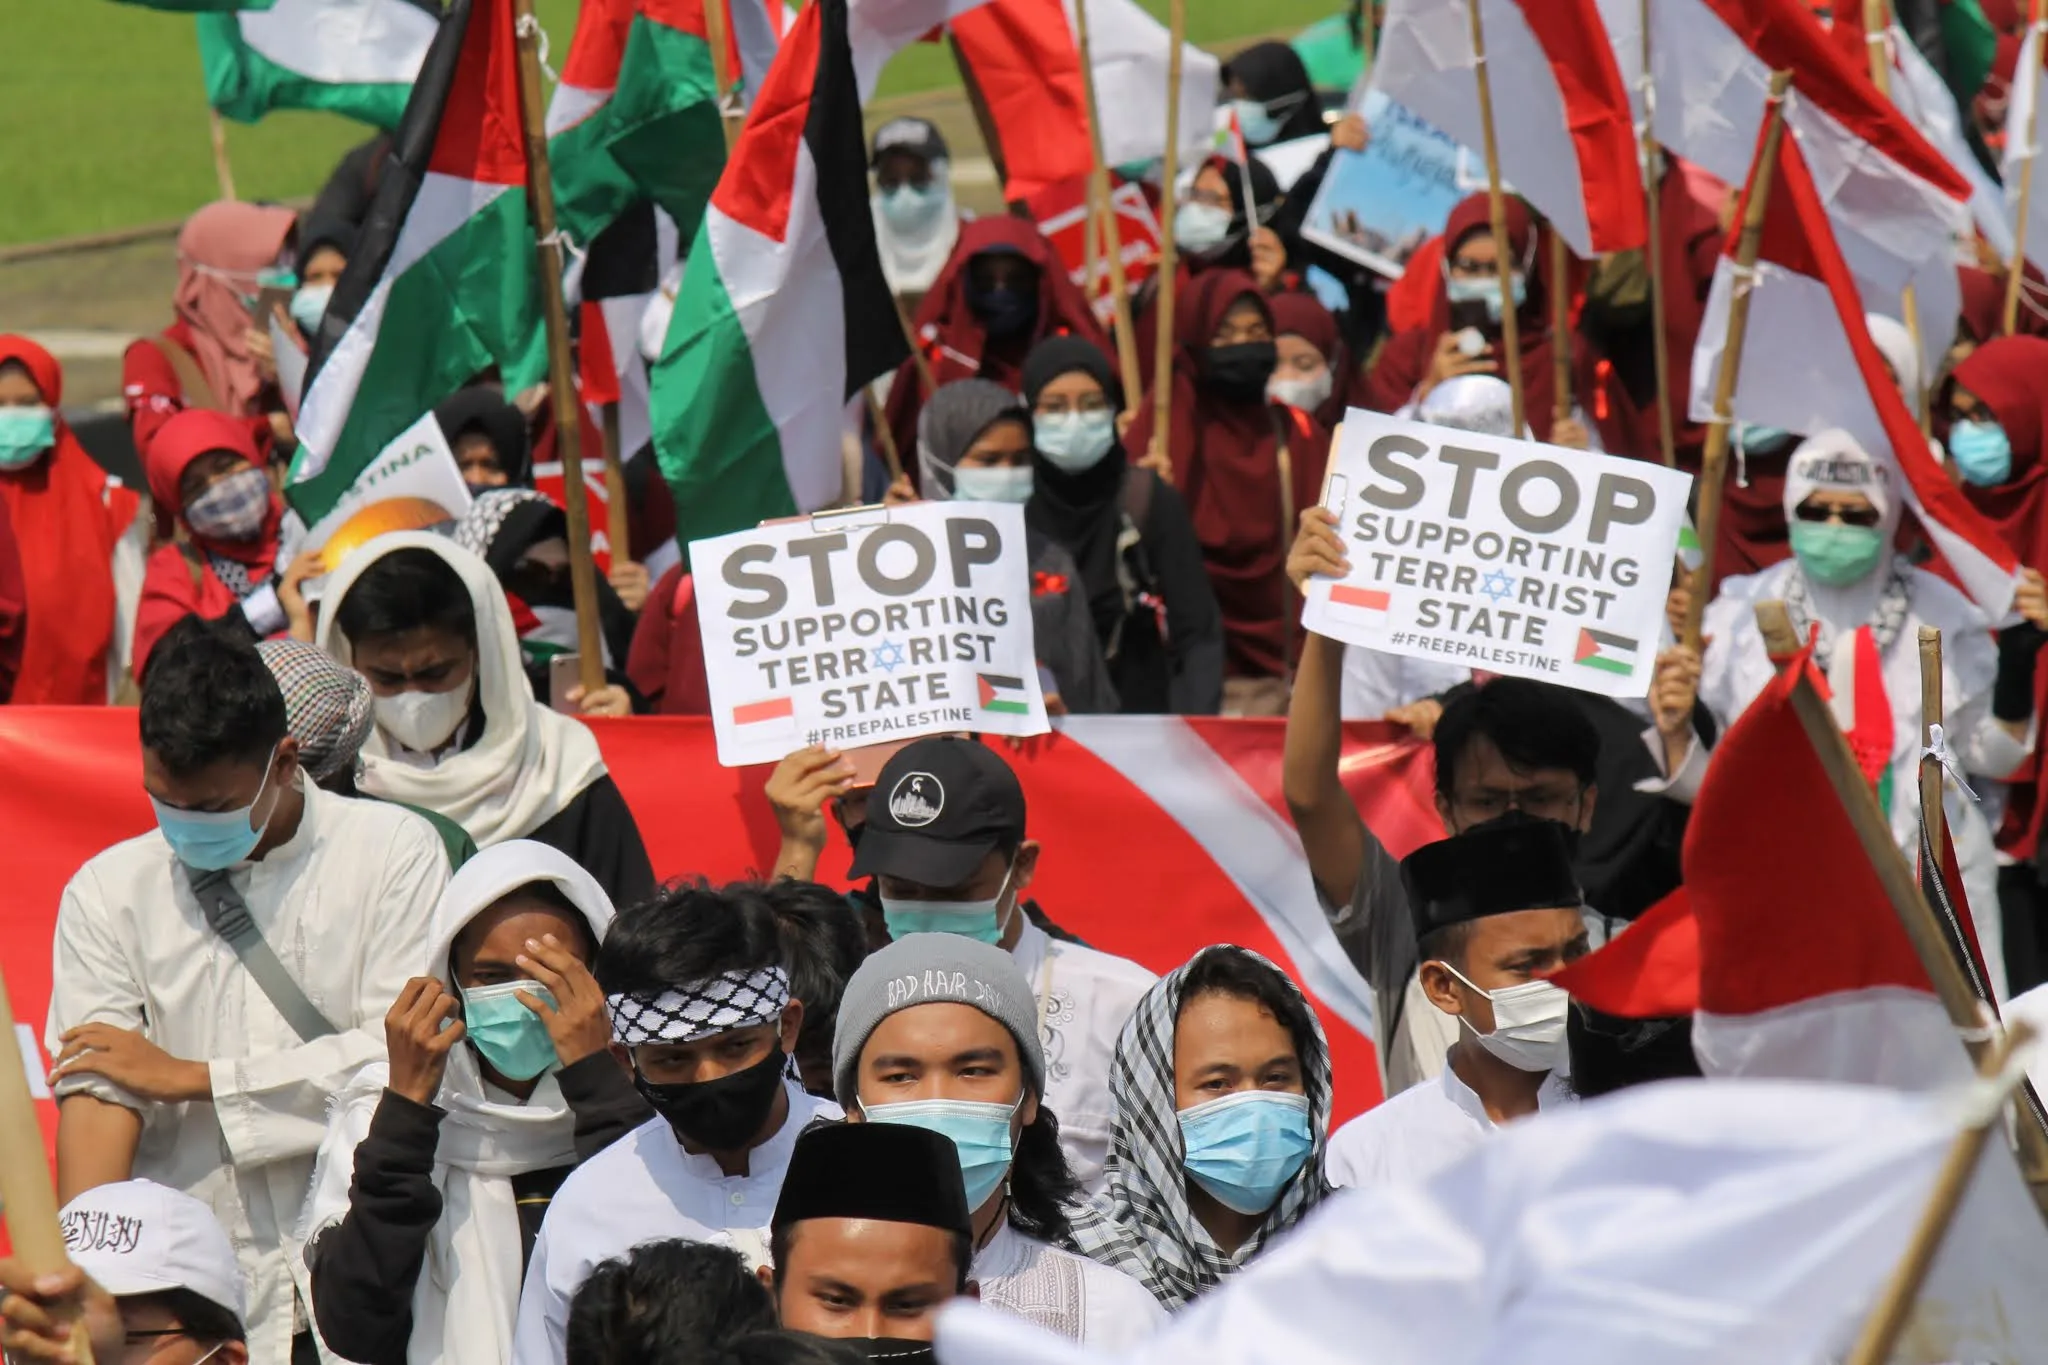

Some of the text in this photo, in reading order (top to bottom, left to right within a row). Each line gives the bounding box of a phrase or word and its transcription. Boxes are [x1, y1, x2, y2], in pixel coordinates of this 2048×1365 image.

[1359, 434, 1657, 545] STOP
[721, 517, 1003, 620] STOP
[1353, 512, 1640, 588] SUPPORTING
[732, 596, 1009, 657] SUPPORTING
[1415, 598, 1549, 647] STATE
[1391, 631, 1561, 672] #FREEPALESTINE
[820, 672, 951, 719] STATE
[805, 707, 973, 745] #FREEPALESTINE
[888, 969, 1001, 1013] BAD HAIR DAY
